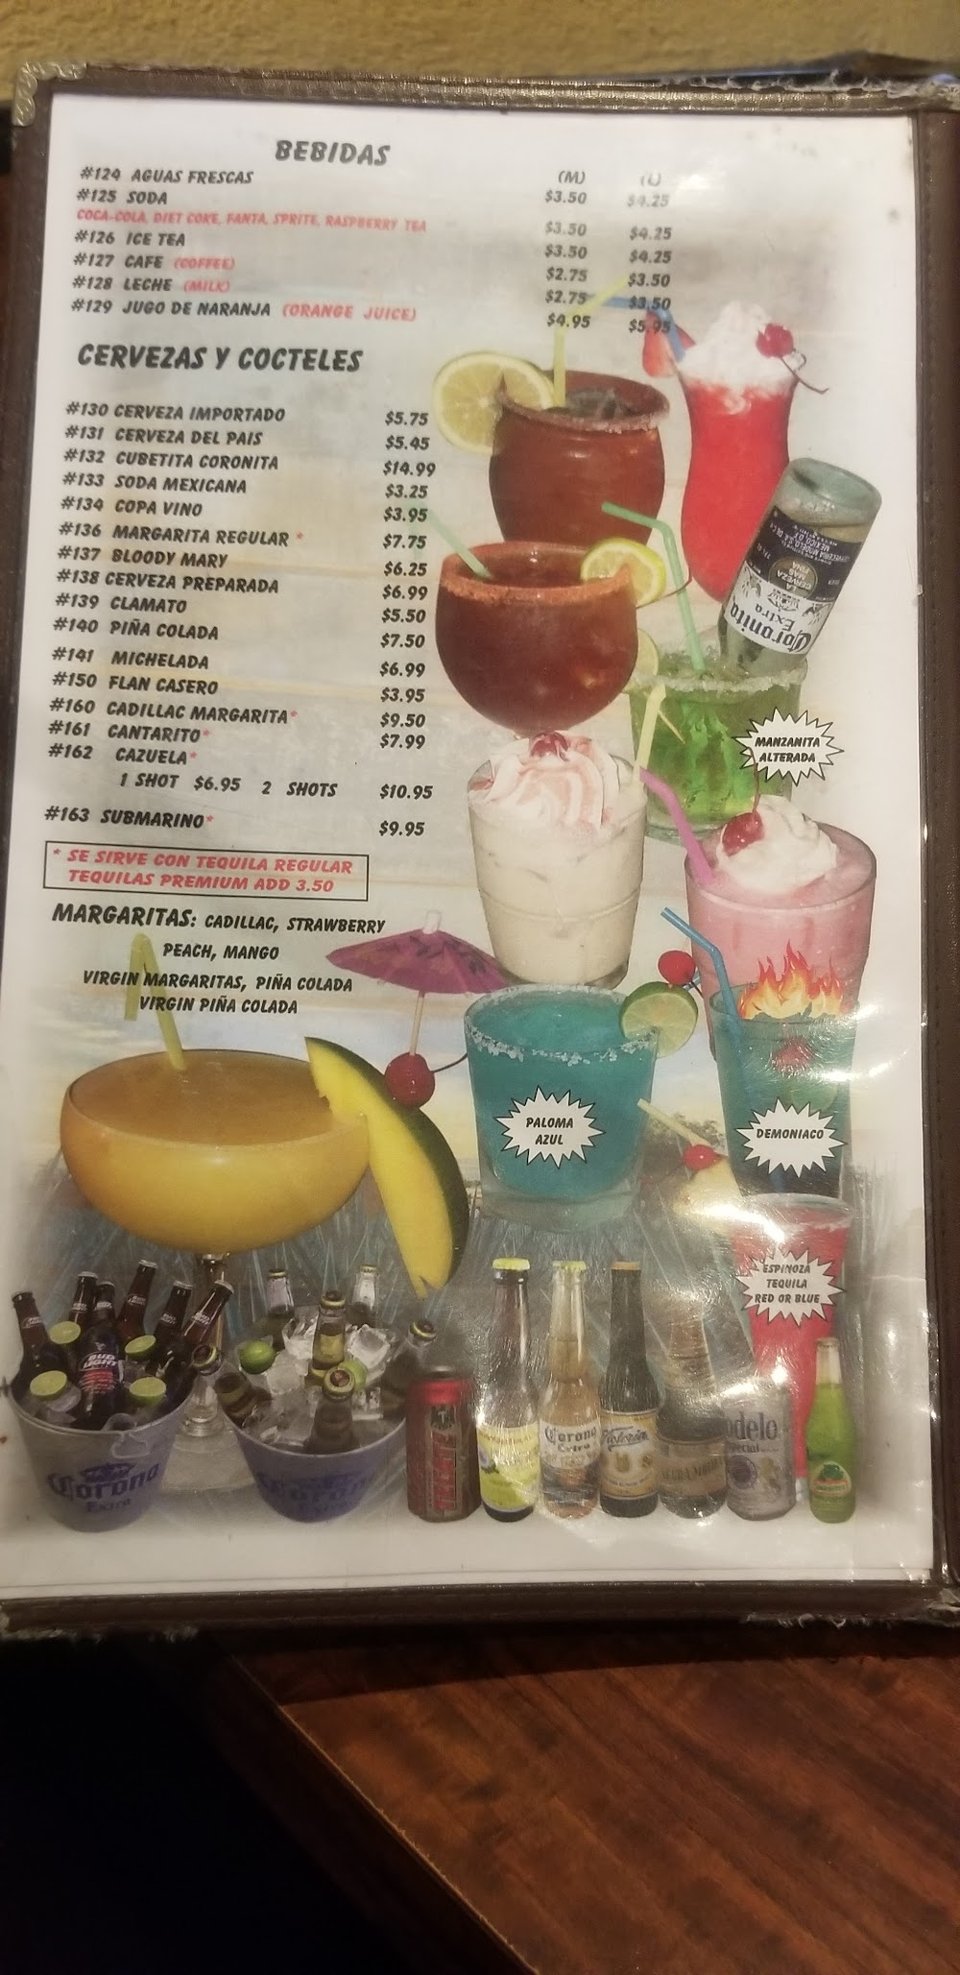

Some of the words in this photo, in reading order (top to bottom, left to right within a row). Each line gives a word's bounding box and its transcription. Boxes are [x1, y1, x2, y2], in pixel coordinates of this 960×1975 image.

[275, 140, 391, 166] BEBIDAS
[80, 167, 121, 181] #124
[131, 169, 183, 183] AGUAS
[188, 171, 254, 184] FRESCAS
[558, 171, 585, 184] (M)
[76, 188, 117, 203] #125
[126, 191, 168, 205] SODA
[545, 190, 587, 204] $3.50
[154, 212, 183, 224] DIET
[325, 215, 397, 230] RASPBERRY
[405, 220, 426, 232] TEA
[545, 221, 587, 236] $3.50
[630, 226, 672, 240] $4.25
[74, 230, 115, 244] #126
[126, 232, 152, 245] ICE
[158, 233, 185, 247] TEA
[73, 253, 114, 267] #127
[125, 255, 163, 269] CAFE
[174, 257, 235, 270] (COFFEE)
[545, 244, 587, 259] $3.50
[629, 250, 672, 264] $4.25
[72, 276, 113, 290] #128
[123, 278, 173, 291] LECHE
[183, 280, 230, 293] (MILK)
[547, 267, 588, 282] $2.75
[628, 273, 670, 287] $3.50
[71, 299, 113, 313] #129
[122, 300, 165, 315] JUGO
[171, 301, 192, 315] DE
[197, 302, 271, 317] NARANJA
[282, 303, 353, 318] (ORANGE
[363, 307, 417, 321] JUICE)
[545, 290, 587, 305] $2.75
[628, 297, 671, 311] $3.50
[547, 314, 591, 329] $4.95
[629, 318, 671, 334] $5.95
[78, 344, 206, 369] CERVEZAS
[215, 348, 231, 369] Y
[238, 348, 364, 372] COCTELES
[66, 402, 109, 417] #130
[114, 405, 184, 421] CERVEZA
[190, 407, 285, 422] IMPORTADO
[385, 411, 428, 426] $5.75
[64, 425, 104, 440] #131
[115, 428, 185, 444] CERVEZA
[191, 431, 220, 444] DEL
[226, 432, 263, 446] PAIS
[385, 436, 430, 450] $5.45
[63, 448, 105, 463] #132
[115, 452, 194, 468] CUBETITA
[199, 455, 279, 470] CORONITA
[383, 461, 436, 477] $14.99
[62, 472, 104, 488] #133
[114, 474, 157, 490] SODA
[163, 478, 247, 494] MEXICANA
[385, 484, 428, 499] $3.25
[60, 496, 104, 511] #134
[115, 499, 157, 515] COPA
[163, 501, 203, 516] VINO
[383, 507, 428, 522] $3.95
[58, 522, 102, 538] #136
[112, 525, 210, 543] MARGARITA
[216, 530, 289, 547] REGULAR
[383, 534, 426, 549] $7.75
[57, 546, 100, 562] #137
[111, 549, 176, 566] BLOODY
[180, 552, 228, 568] MARY
[383, 562, 427, 577] $6.25
[56, 569, 100, 585] #138
[105, 572, 176, 589] CERVEZA
[182, 576, 279, 593] PREPARADA
[382, 585, 428, 600] $6.99
[55, 592, 99, 609] #139
[110, 596, 187, 614] CLAMATO
[381, 608, 426, 623] $5.50
[755, 603, 795, 631] Extra
[52, 617, 99, 633] #140
[110, 618, 151, 637] PIÑA
[156, 624, 219, 641] COLADA
[380, 633, 425, 649] $7.50
[730, 602, 812, 653] Coronita
[52, 647, 94, 662] #141
[111, 650, 209, 670] MICHELADA
[380, 662, 426, 677] $6.99
[52, 672, 98, 688] #150
[108, 675, 151, 692] FLAN
[156, 678, 218, 695] CASERO
[380, 687, 426, 703] $3.95
[49, 698, 95, 714] #160
[106, 701, 186, 719] CADILLAC
[380, 713, 426, 728] $9.50
[48, 721, 90, 736] #161
[380, 735, 426, 750] $7.99
[755, 737, 820, 747] MANZANITA
[48, 744, 93, 760] #162
[759, 753, 815, 763] ALTERADA
[119, 773, 128, 787] 1
[135, 773, 180, 789] SHOT
[194, 776, 241, 792] $6.95
[261, 781, 272, 796] 2
[287, 782, 338, 798] SHOTS
[379, 784, 433, 799] $10.95
[44, 806, 90, 822] #163
[379, 820, 424, 836] $9.95
[67, 849, 90, 863] SE
[94, 850, 148, 866] SIRVE
[153, 854, 189, 868] CON
[196, 856, 268, 872] TEQUILA
[274, 859, 353, 874] REGULAR
[68, 869, 155, 887] TEQUILAS
[160, 875, 248, 890] PREMIUM
[254, 878, 290, 891] ADD
[296, 879, 333, 893] 3.50
[52, 904, 197, 928] MARGARITAS:
[205, 915, 279, 932] CADILLAC,
[287, 917, 386, 933] STRAWBERRY
[163, 943, 216, 960] PEACH,
[223, 945, 279, 960] MANGO
[83, 970, 139, 986] VIRGIN
[143, 973, 247, 991] MARGARITAS,
[256, 972, 292, 991] PIÑA
[297, 977, 353, 991] COLADA
[140, 996, 195, 1011] VIRGIN
[199, 995, 236, 1013] PIÑA
[241, 999, 298, 1014] COLADA
[526, 1117, 573, 1129] PALOMA
[534, 1133, 564, 1145] AZUL
[756, 1128, 824, 1140] DEMONIACO
[766, 1278, 808, 1289] TEQUILA
[754, 1293, 774, 1304] RED
[779, 1293, 792, 1304] OR
[795, 1293, 820, 1304] BLUE
